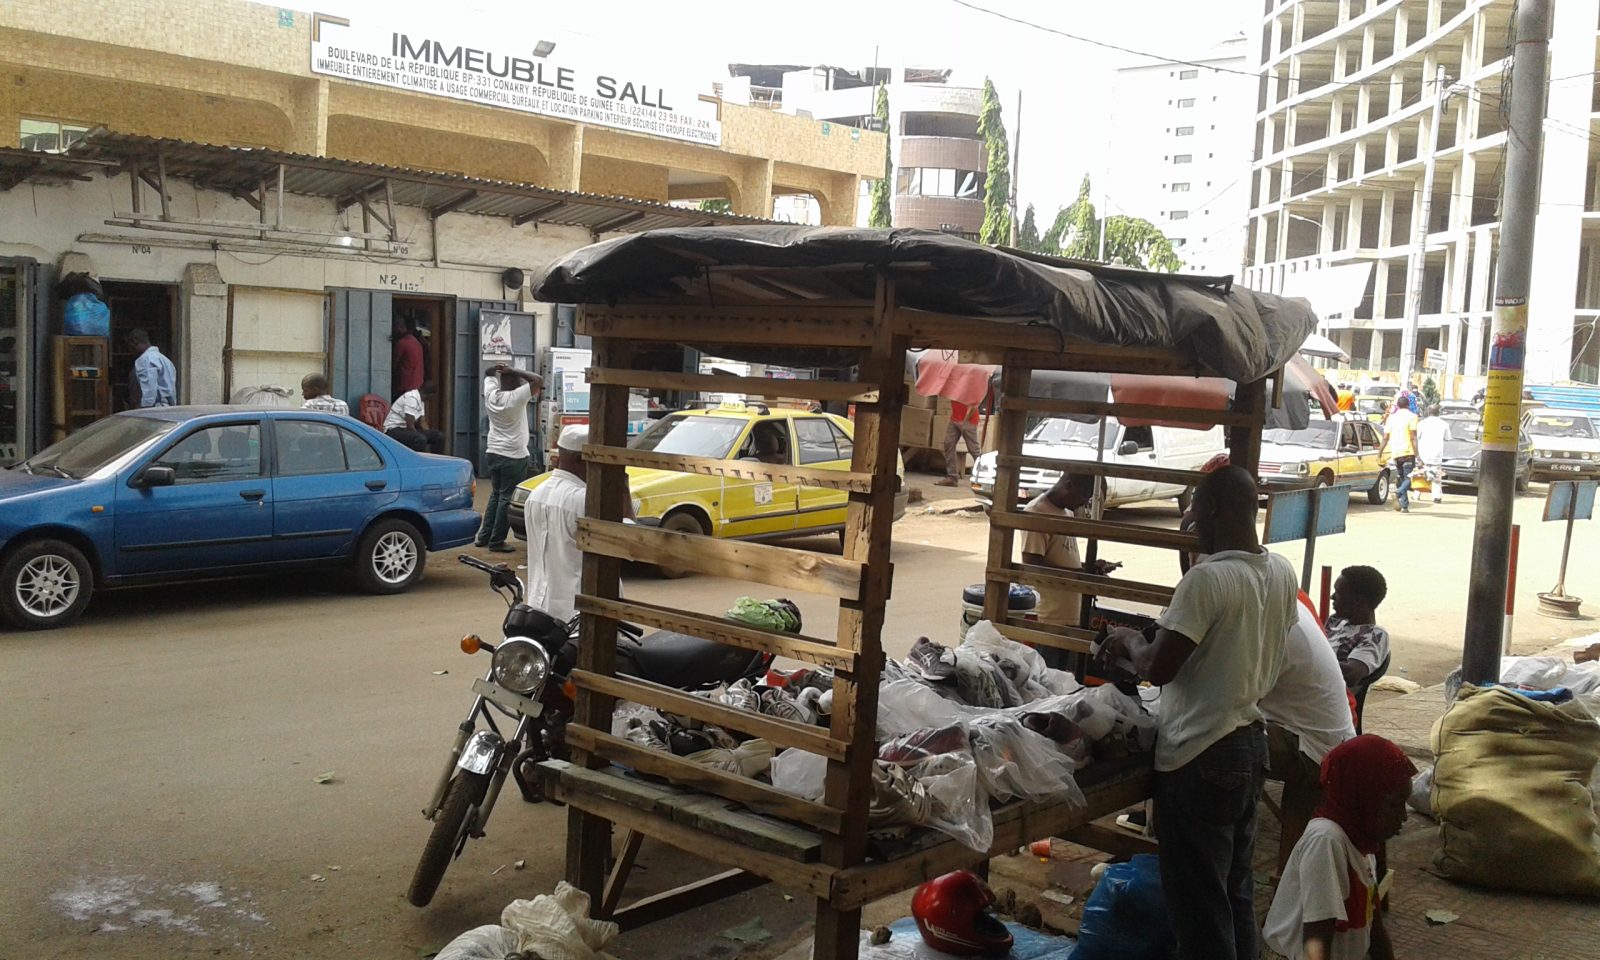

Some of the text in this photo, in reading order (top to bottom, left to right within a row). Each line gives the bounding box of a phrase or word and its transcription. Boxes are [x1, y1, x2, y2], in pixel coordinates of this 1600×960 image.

[317, 57, 350, 75] IMMEUBLE
[446, 82, 468, 96] USAGE
[470, 87, 511, 104] COMMERCIAL
[512, 95, 540, 109] BUREAUX
[542, 101, 549, 111] ET
[551, 102, 578, 116] LOCATION
[580, 107, 603, 121] PARKING
[659, 123, 665, 132] ET
[666, 124, 687, 137] GROUPE
[328, 46, 378, 66] BOULEVARD
[381, 56, 392, 69] DE
[394, 59, 406, 72] LA
[493, 78, 530, 95] CONAKRY
[579, 95, 588, 106] DE
[658, 111, 667, 121] 23
[697, 119, 710, 129] 224
[392, 32, 673, 111] IMMEUBLE SALL
